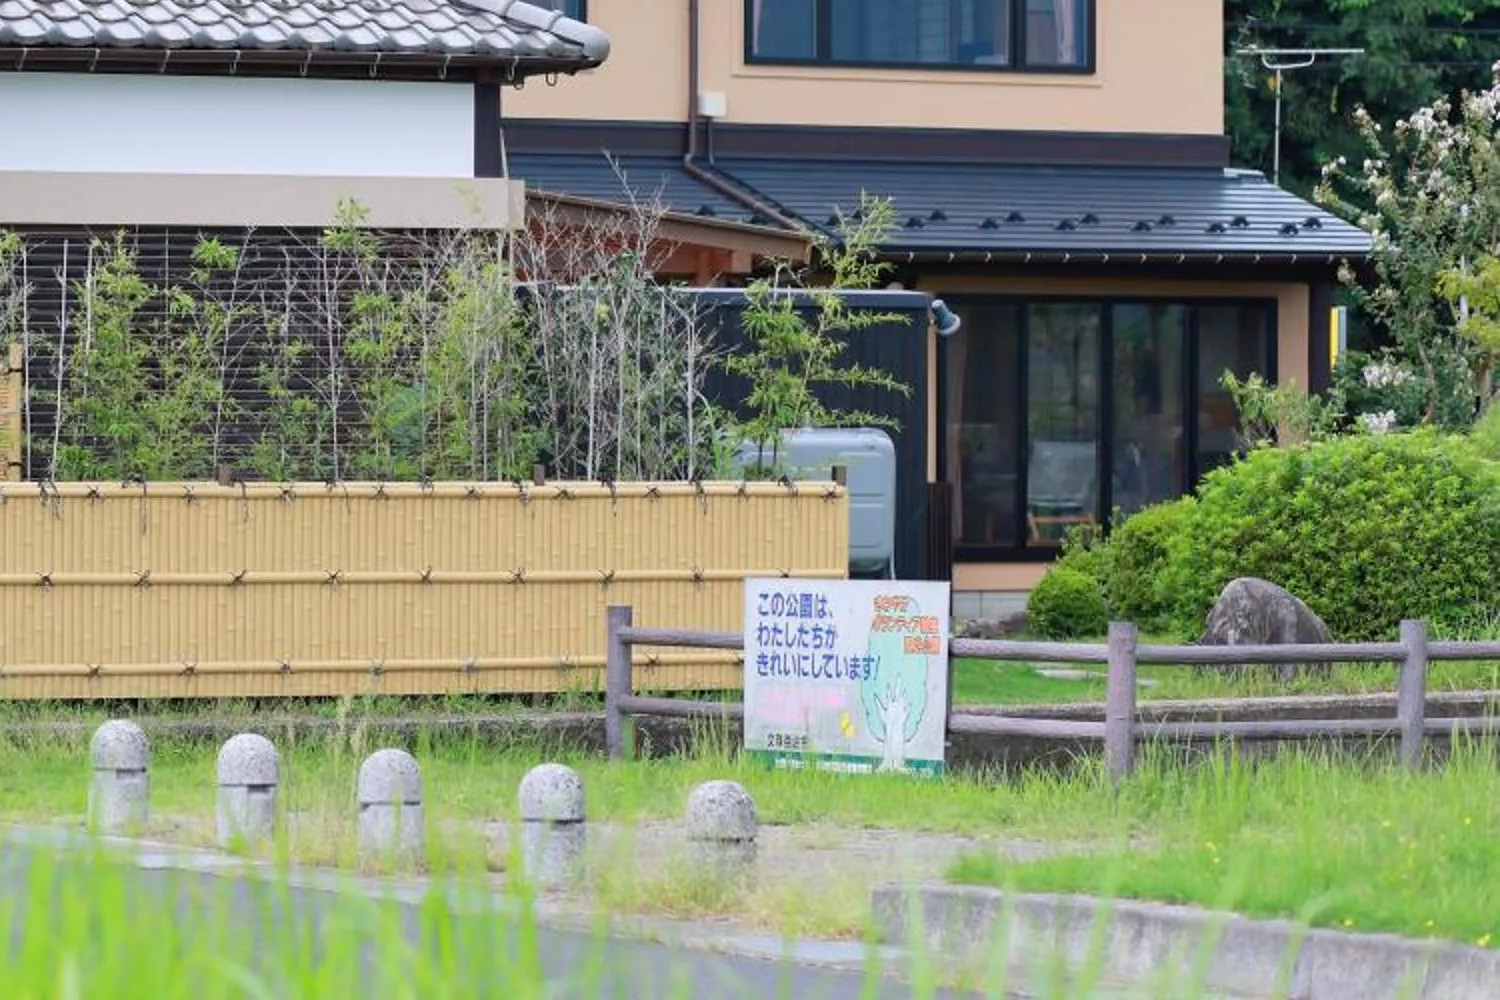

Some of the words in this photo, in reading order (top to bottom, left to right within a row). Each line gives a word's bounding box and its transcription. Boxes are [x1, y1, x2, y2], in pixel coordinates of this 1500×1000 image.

[757, 592, 833, 618] この公園は、
[757, 621, 837, 649] わたしたちが
